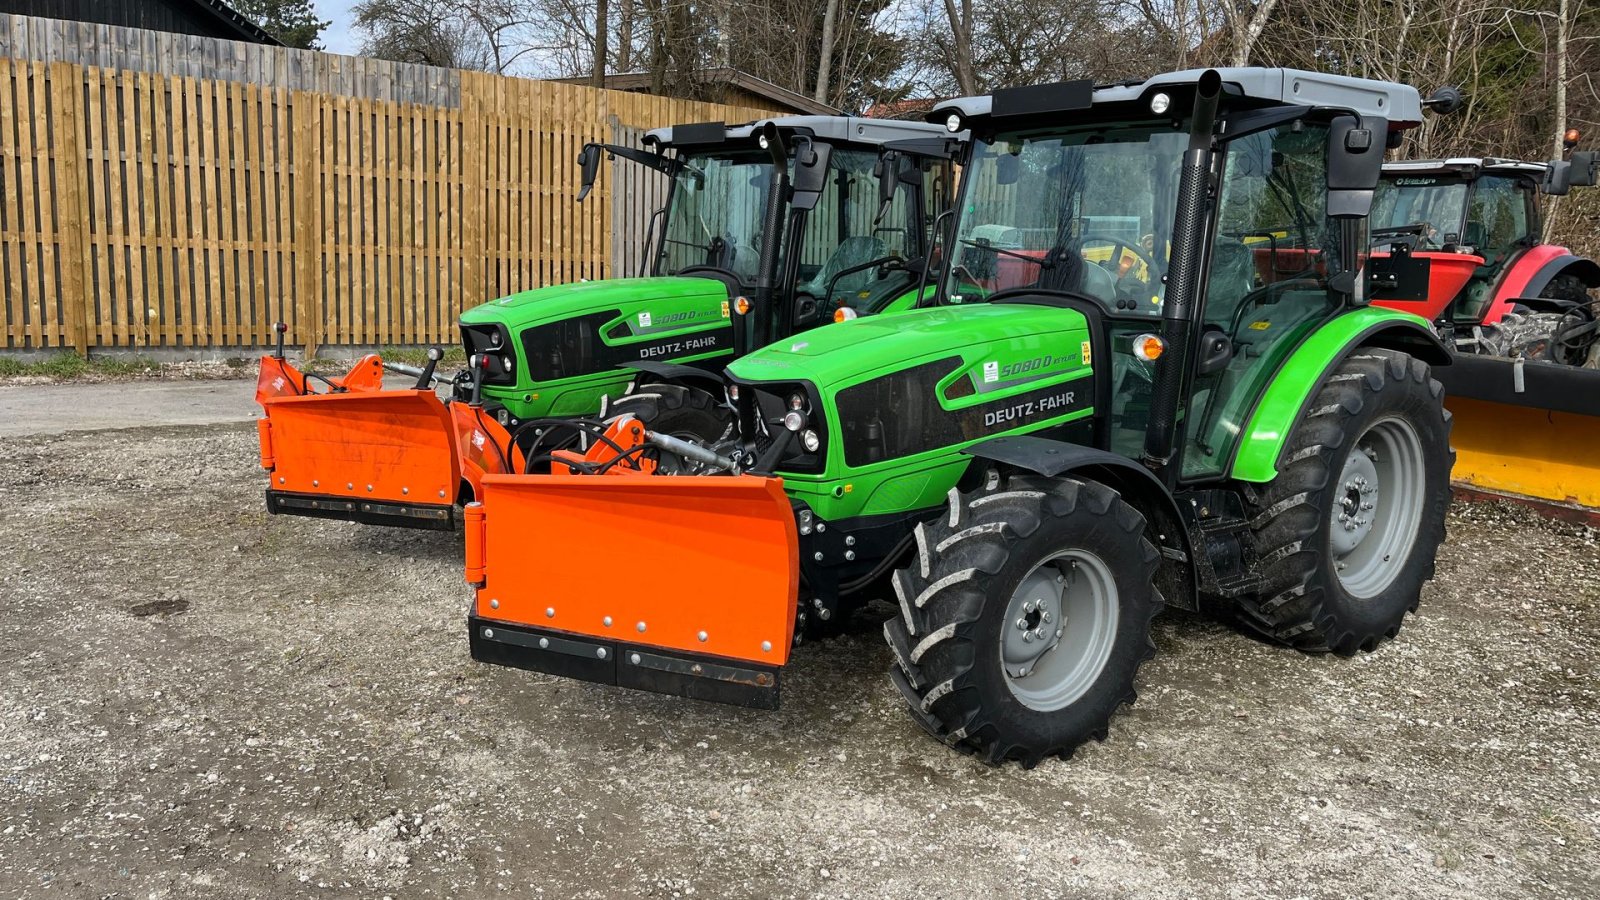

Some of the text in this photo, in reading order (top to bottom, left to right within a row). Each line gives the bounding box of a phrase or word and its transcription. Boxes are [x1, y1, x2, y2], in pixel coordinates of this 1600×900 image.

[640, 336, 716, 358] DEUTZ-FAHR
[1001, 358, 1041, 377] 5080
[1043, 355, 1052, 367] D
[985, 392, 1075, 426] DEUTZ-FAHR
